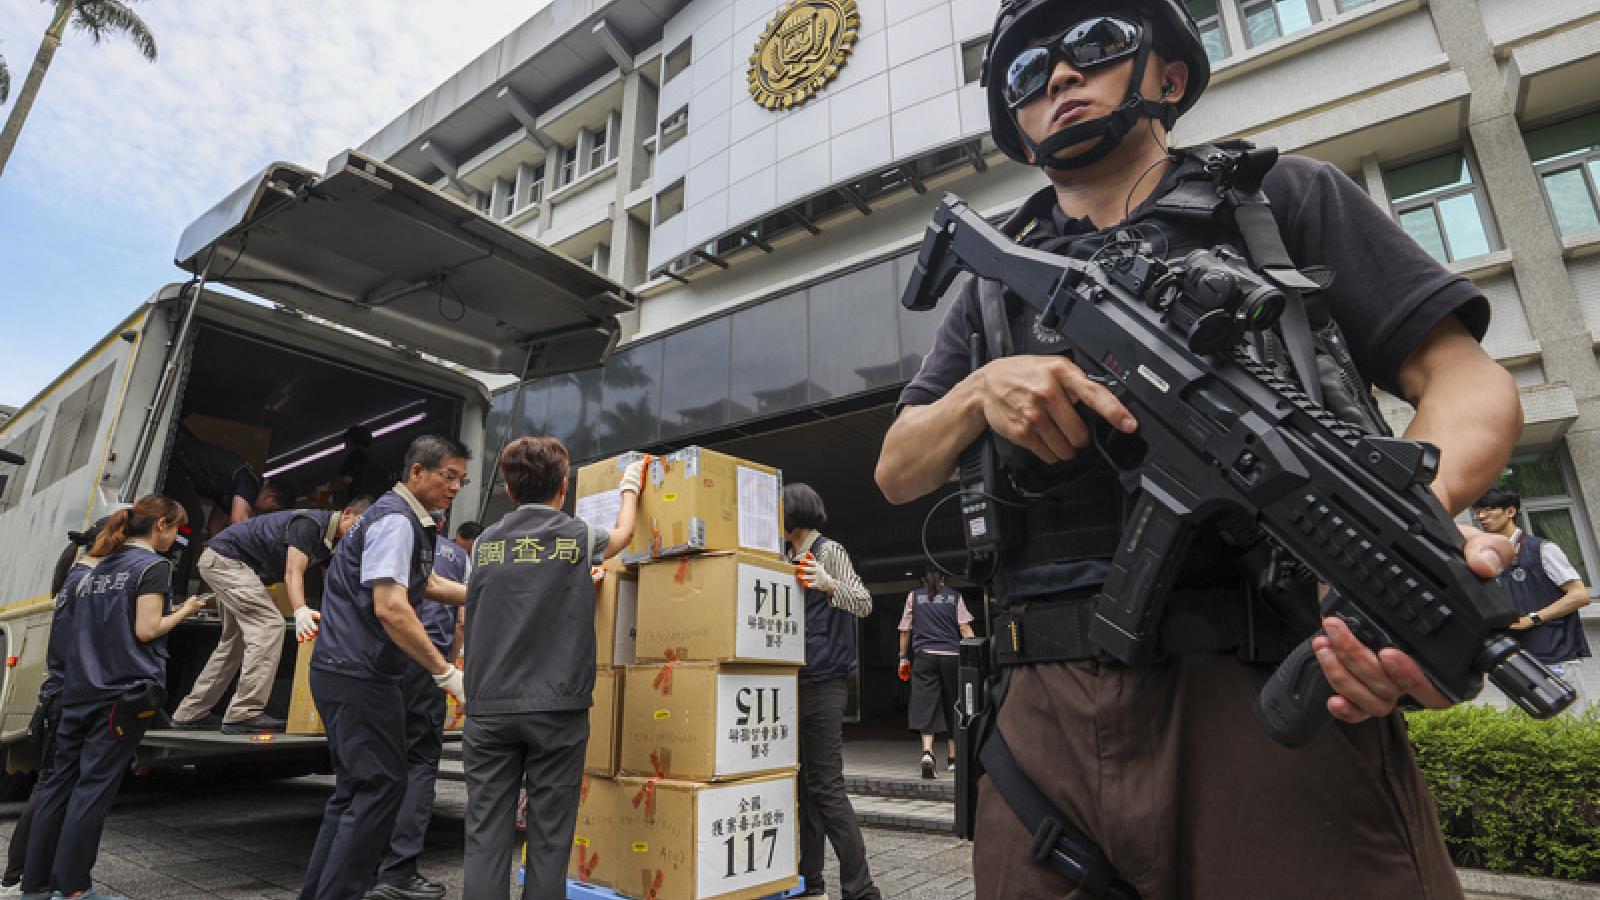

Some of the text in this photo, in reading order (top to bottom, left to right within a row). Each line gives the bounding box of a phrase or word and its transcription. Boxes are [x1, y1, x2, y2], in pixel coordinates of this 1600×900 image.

[478, 535, 580, 567] 調查局
[753, 578, 792, 618] 114
[735, 687, 780, 726] 115
[722, 826, 778, 879] 117
